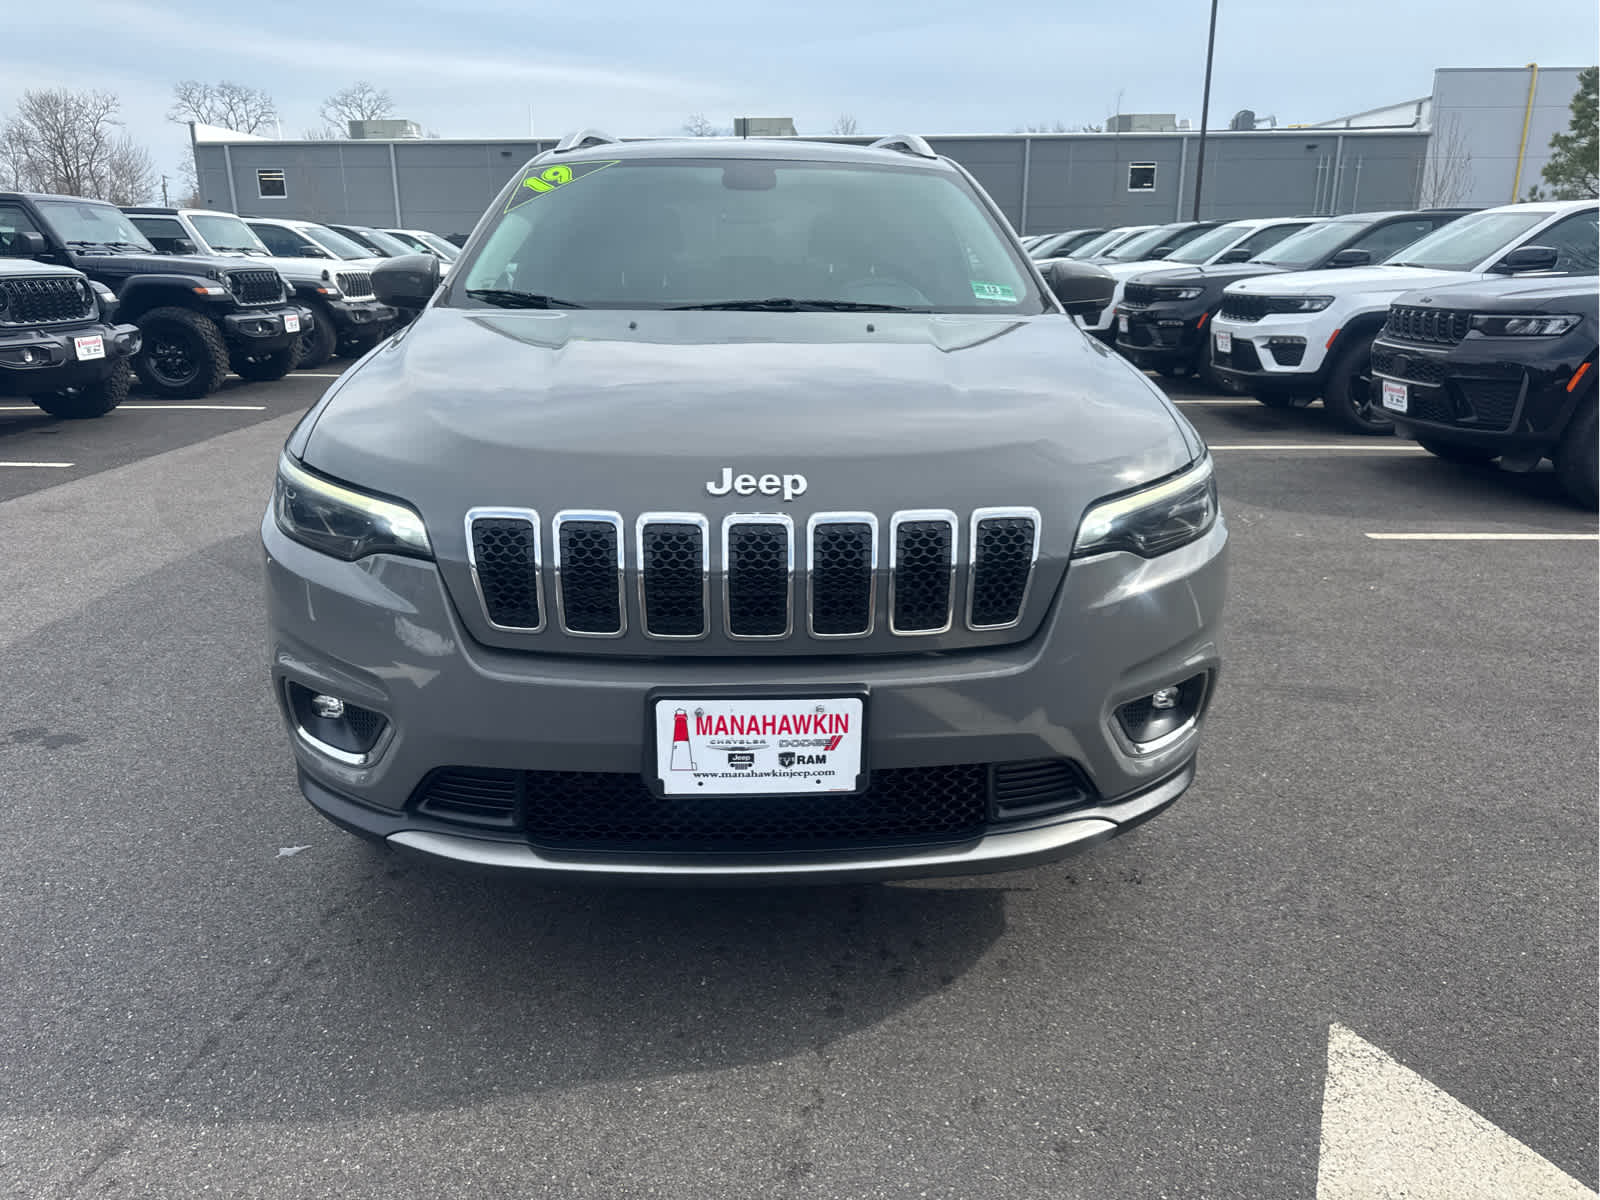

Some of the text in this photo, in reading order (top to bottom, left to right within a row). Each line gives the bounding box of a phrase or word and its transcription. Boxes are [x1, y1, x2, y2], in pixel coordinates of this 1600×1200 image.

[523, 165, 573, 193] 19
[706, 467, 808, 502] Jeep
[696, 713, 849, 736] MANAHAWKIN
[732, 753, 751, 762] Jeep
[796, 754, 827, 765] RAM
[693, 769, 836, 779] www.manahawkinjeep.com
